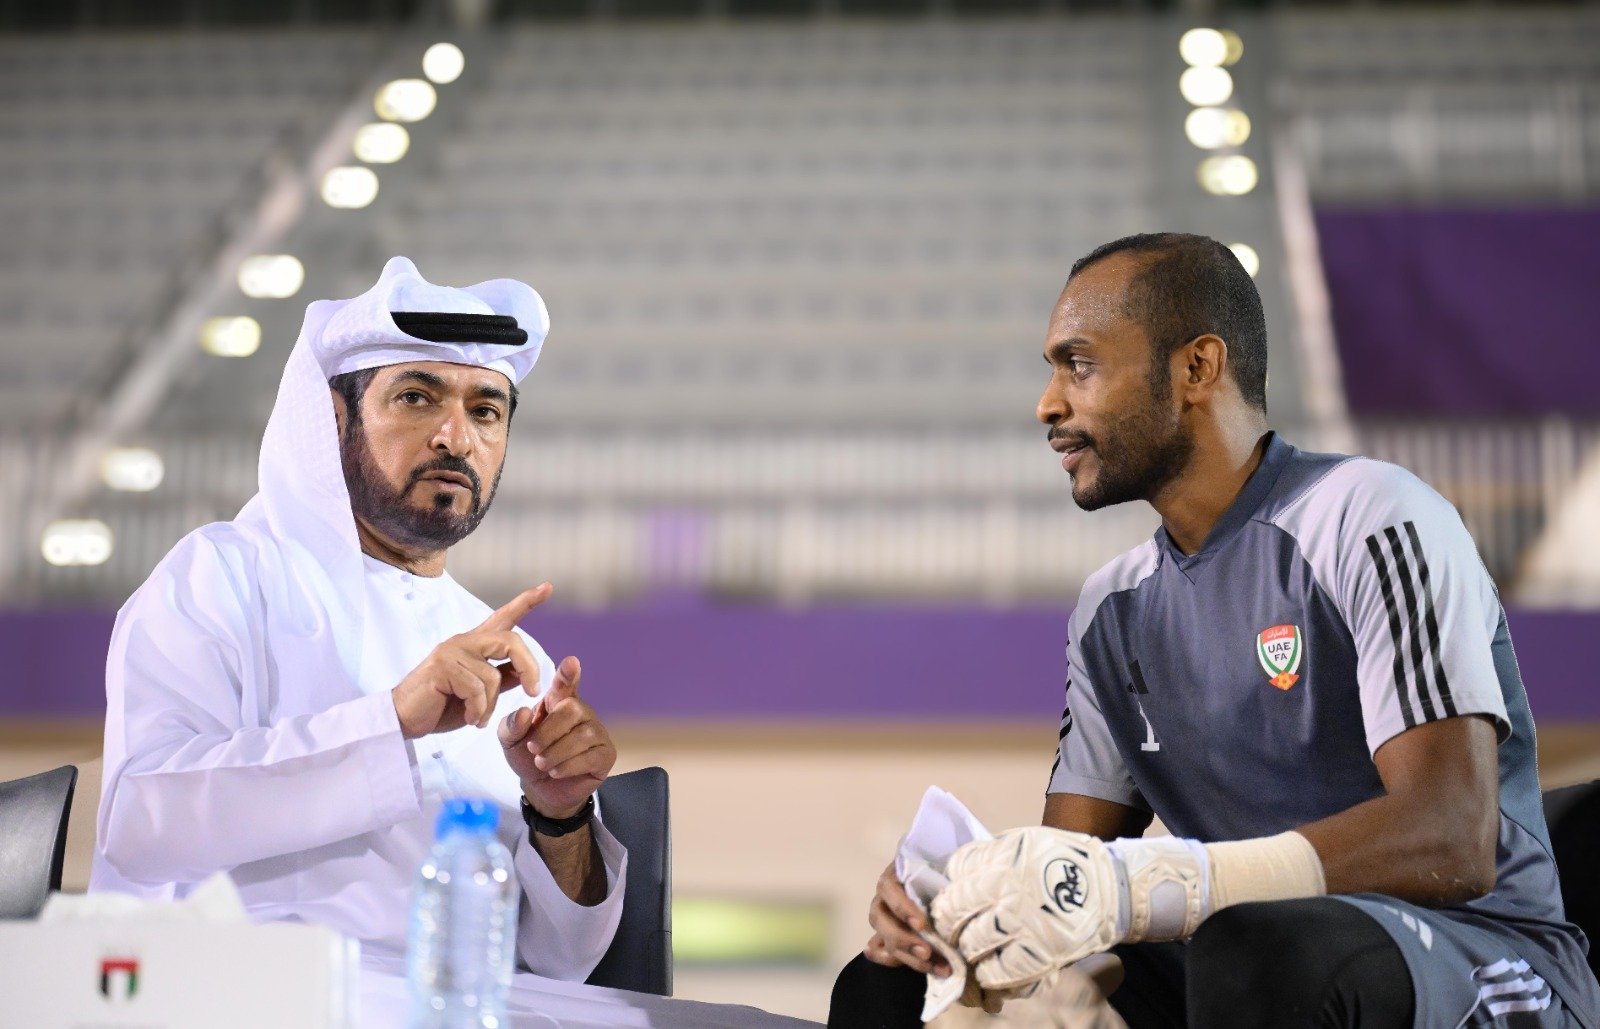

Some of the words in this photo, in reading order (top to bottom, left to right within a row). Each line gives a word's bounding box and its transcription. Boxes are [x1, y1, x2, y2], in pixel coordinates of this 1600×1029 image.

[1268, 641, 1291, 653] UAE
[1274, 653, 1288, 661] FA
[1138, 700, 1160, 752] 1
